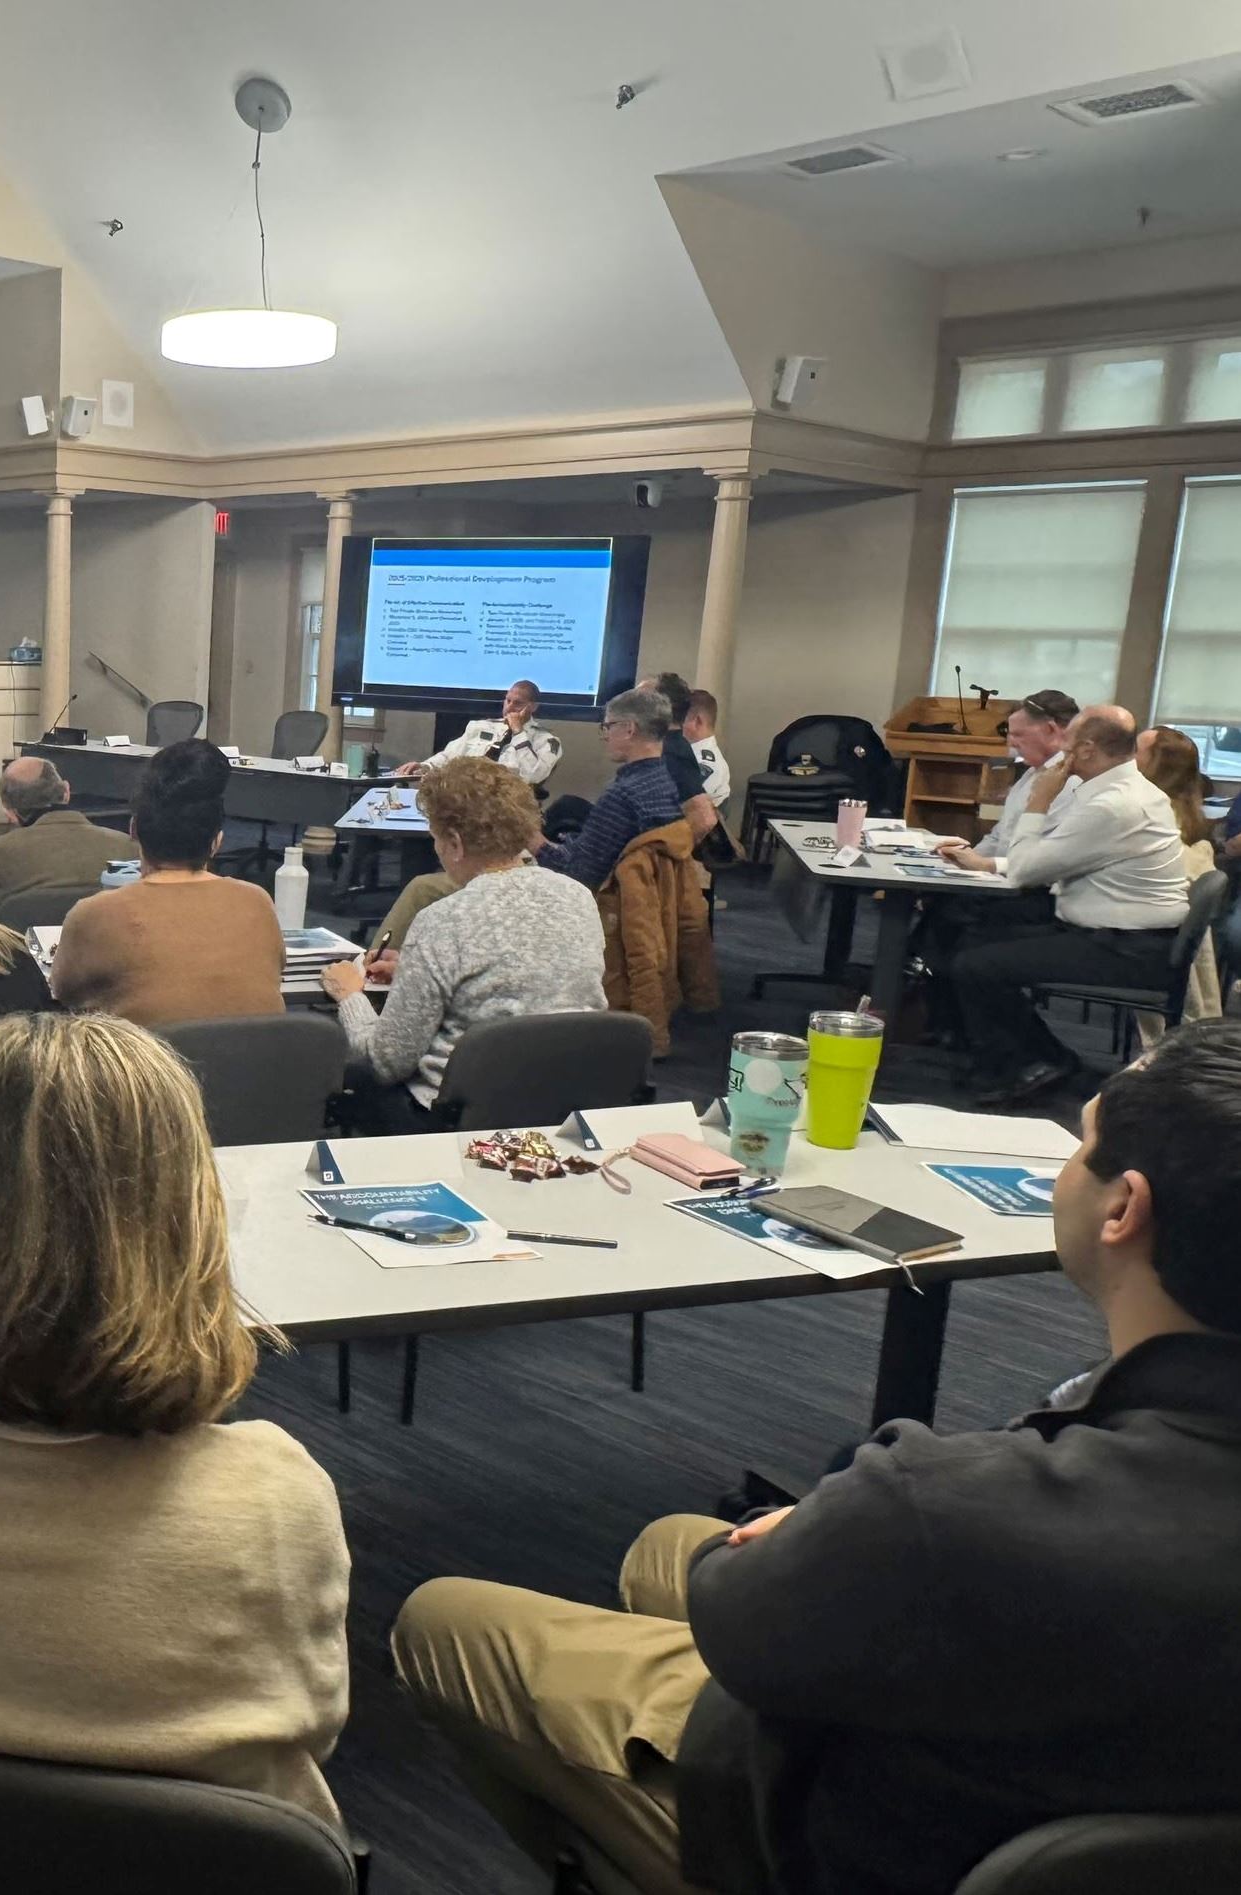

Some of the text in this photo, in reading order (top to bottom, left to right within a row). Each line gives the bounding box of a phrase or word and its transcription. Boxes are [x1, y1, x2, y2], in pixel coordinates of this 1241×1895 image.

[426, 574, 471, 583] Professional
[472, 575, 522, 584] Development
[523, 576, 556, 585] Program
